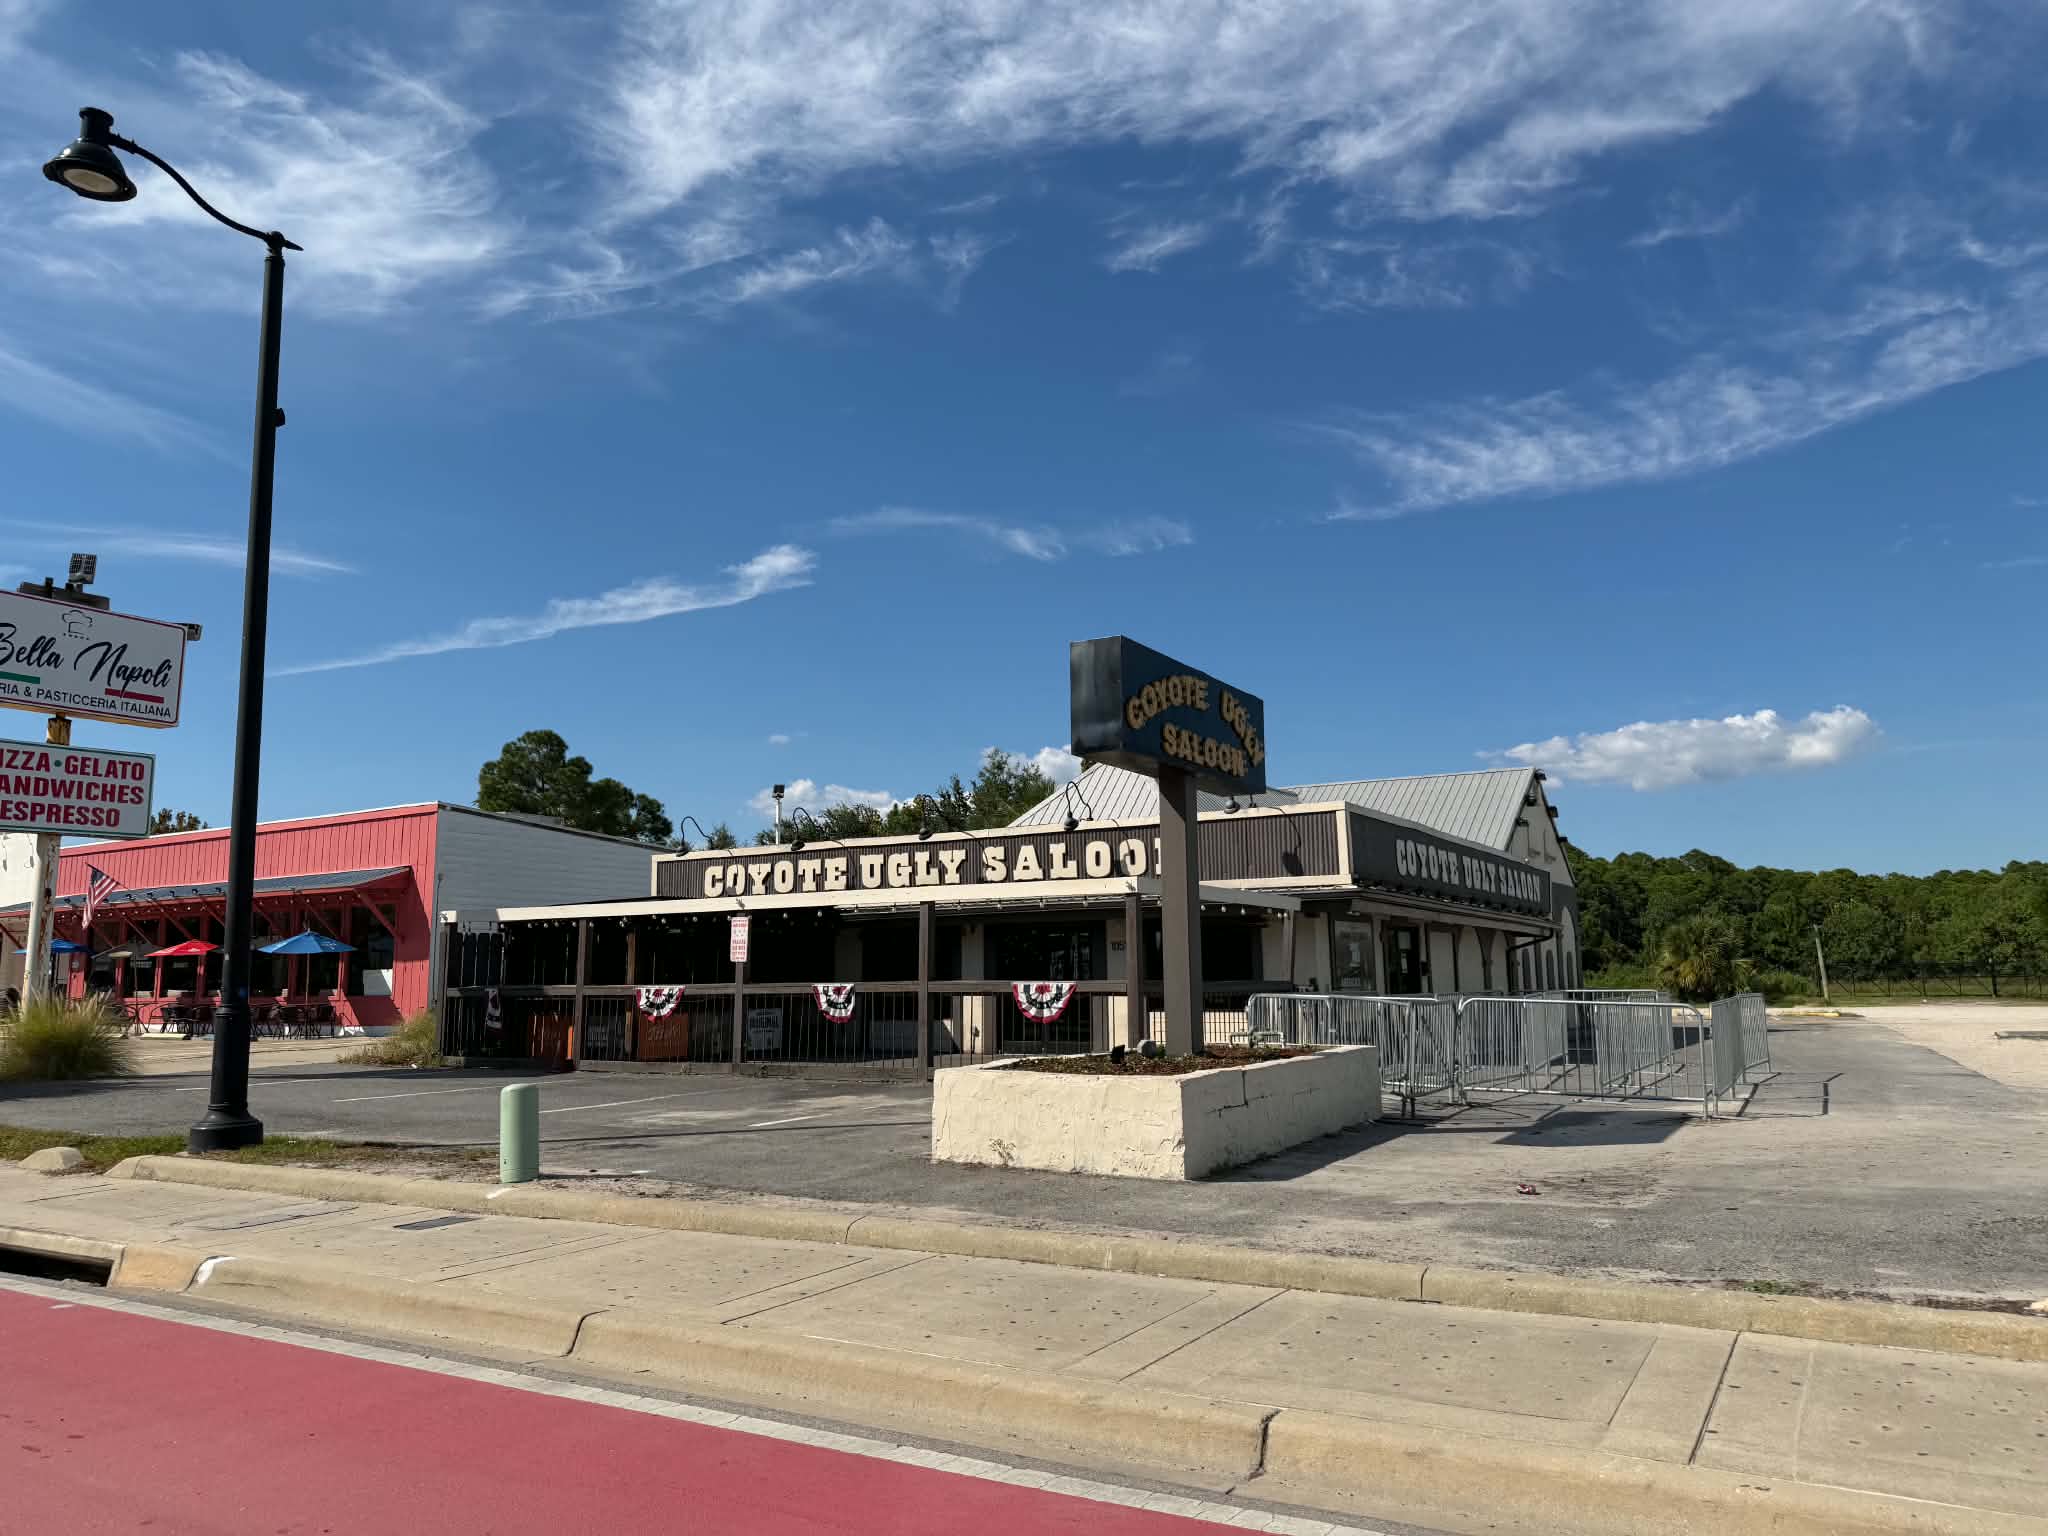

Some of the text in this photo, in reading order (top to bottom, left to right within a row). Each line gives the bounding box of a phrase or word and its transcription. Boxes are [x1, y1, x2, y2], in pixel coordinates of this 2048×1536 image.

[0, 623, 172, 698] Bella Napoli
[24, 686, 32, 697] &
[36, 688, 117, 711] PASTICCERIA
[120, 701, 171, 718] ITALIANA
[1127, 675, 1209, 729] COYOTE
[0, 749, 145, 781] IZZA GELATO
[1163, 722, 1248, 776] SALOON
[0, 774, 144, 804] ANDWICHES
[0, 799, 120, 827] ESPRESSO
[704, 837, 1161, 898] COYOTE UGLY SALOO
[1396, 839, 1540, 902] COYOTE UGLY SALOON
